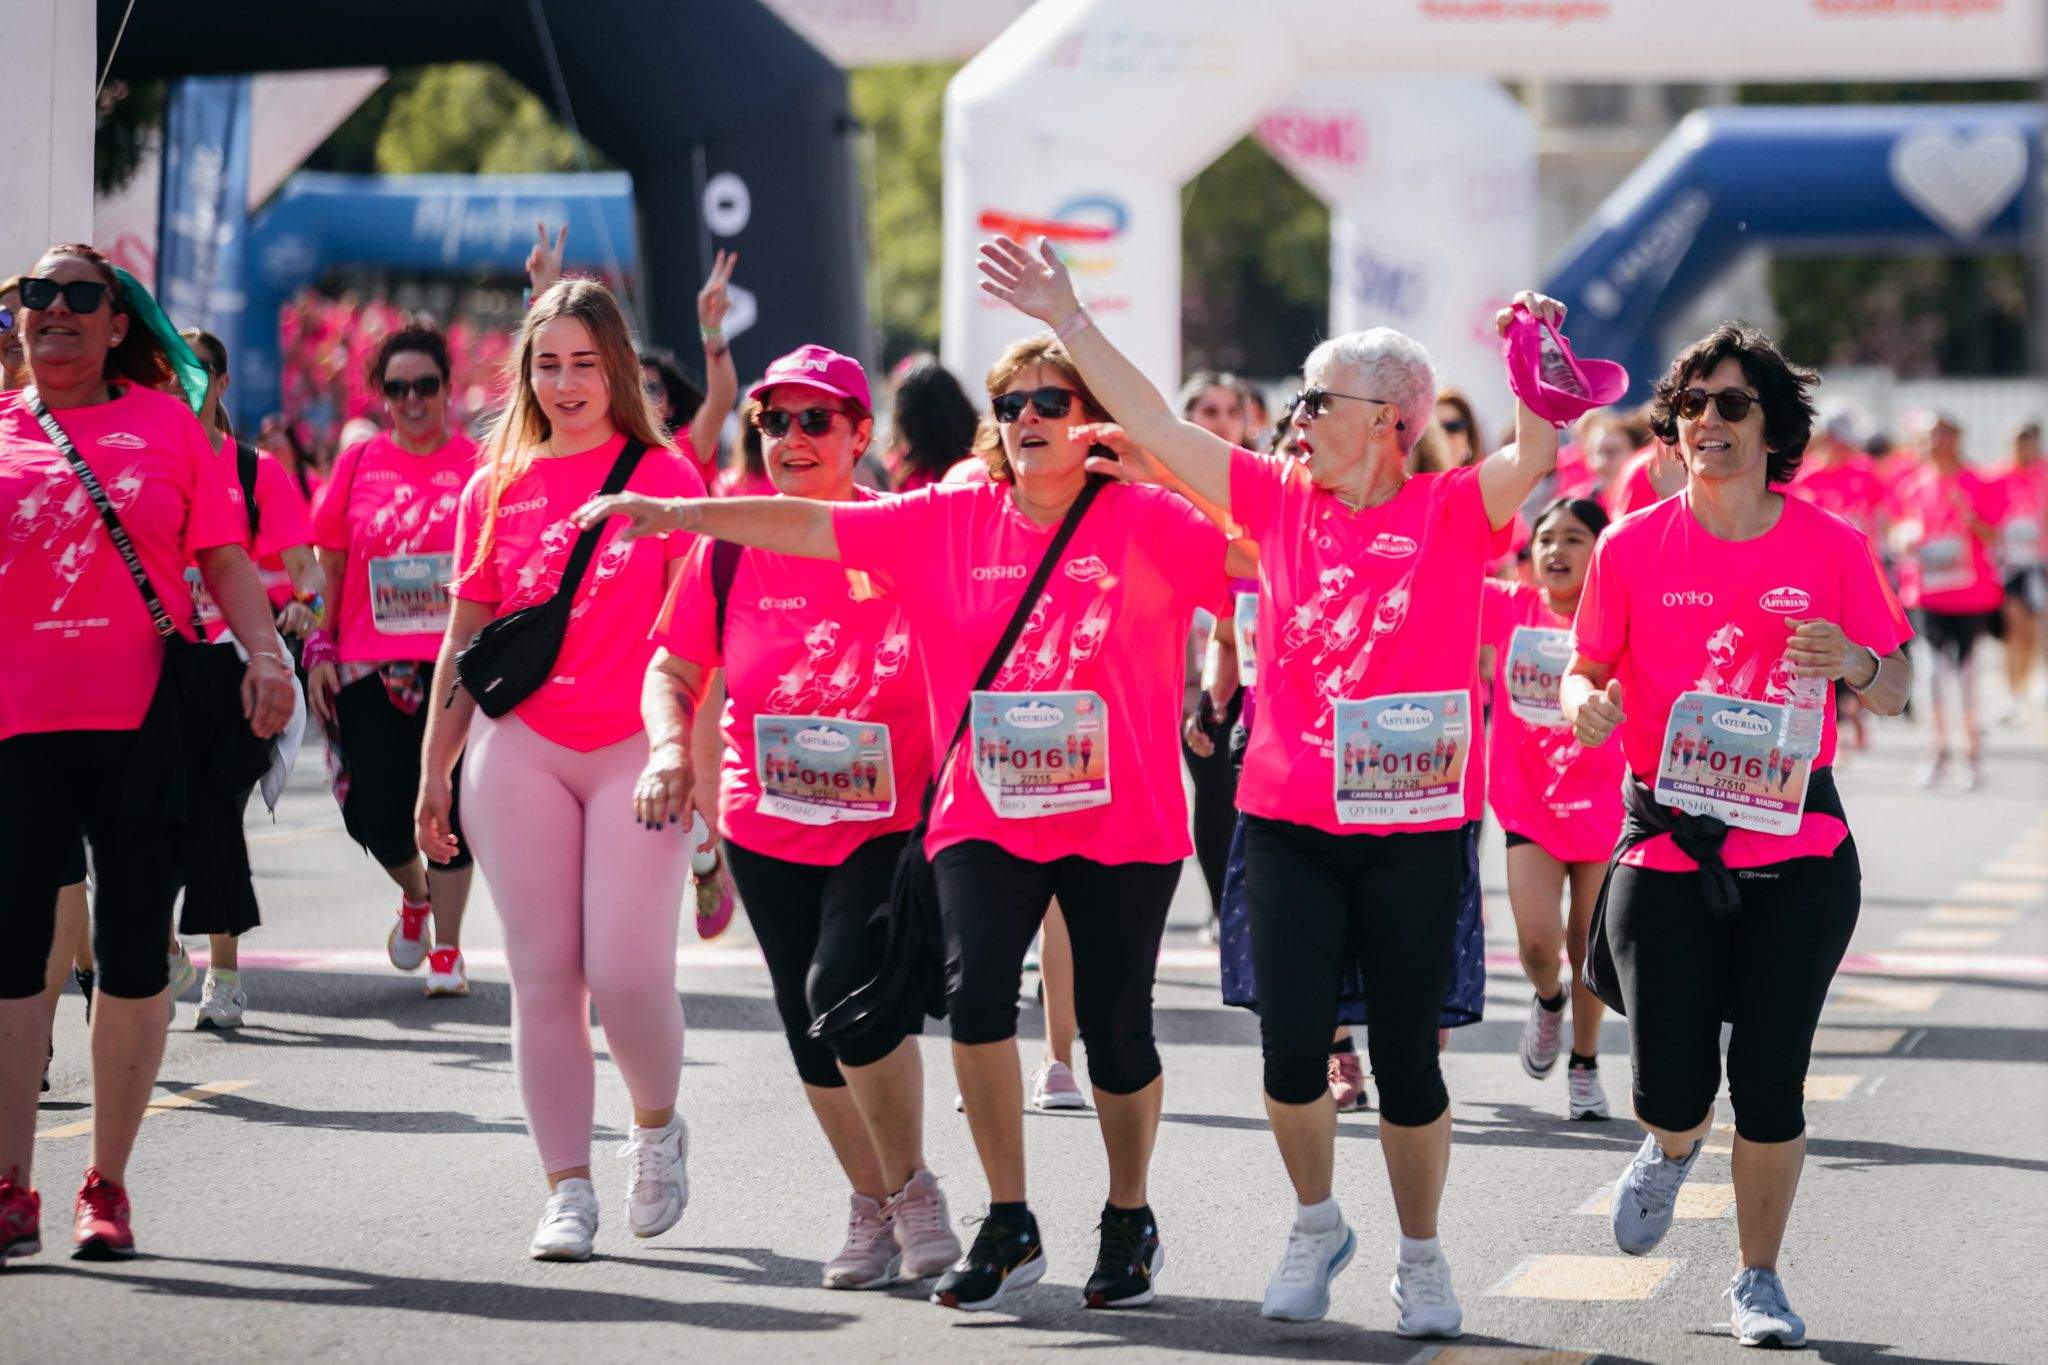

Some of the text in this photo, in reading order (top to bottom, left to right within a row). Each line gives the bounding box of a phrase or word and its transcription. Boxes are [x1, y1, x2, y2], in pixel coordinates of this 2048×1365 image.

[73, 460, 110, 515] BIMBA
[498, 496, 549, 518] OYSHO
[110, 526, 147, 586] BIMBA
[971, 564, 1027, 580] OYSHO
[1764, 597, 1809, 608] ASTURIANA
[1381, 715, 1431, 726] ASTURIANA
[1716, 714, 1770, 733] ASTURIANA
[1011, 749, 1064, 769] 016
[1383, 752, 1431, 774] 016
[1709, 751, 1763, 779] 016
[801, 769, 850, 789] 016
[1714, 777, 1746, 792] 27510
[1351, 790, 1383, 799] CARRERA
[1384, 790, 1394, 799] DE
[1395, 790, 1404, 799] LA
[1673, 780, 1705, 795] CARRERA
[1706, 787, 1717, 798] DE
[1717, 789, 1726, 799] LA
[1726, 790, 1751, 804] MUJER
[1756, 796, 1784, 810] MADRID
[1349, 804, 1394, 817] OYSHO
[1669, 796, 1783, 827] OYSHO Santander
